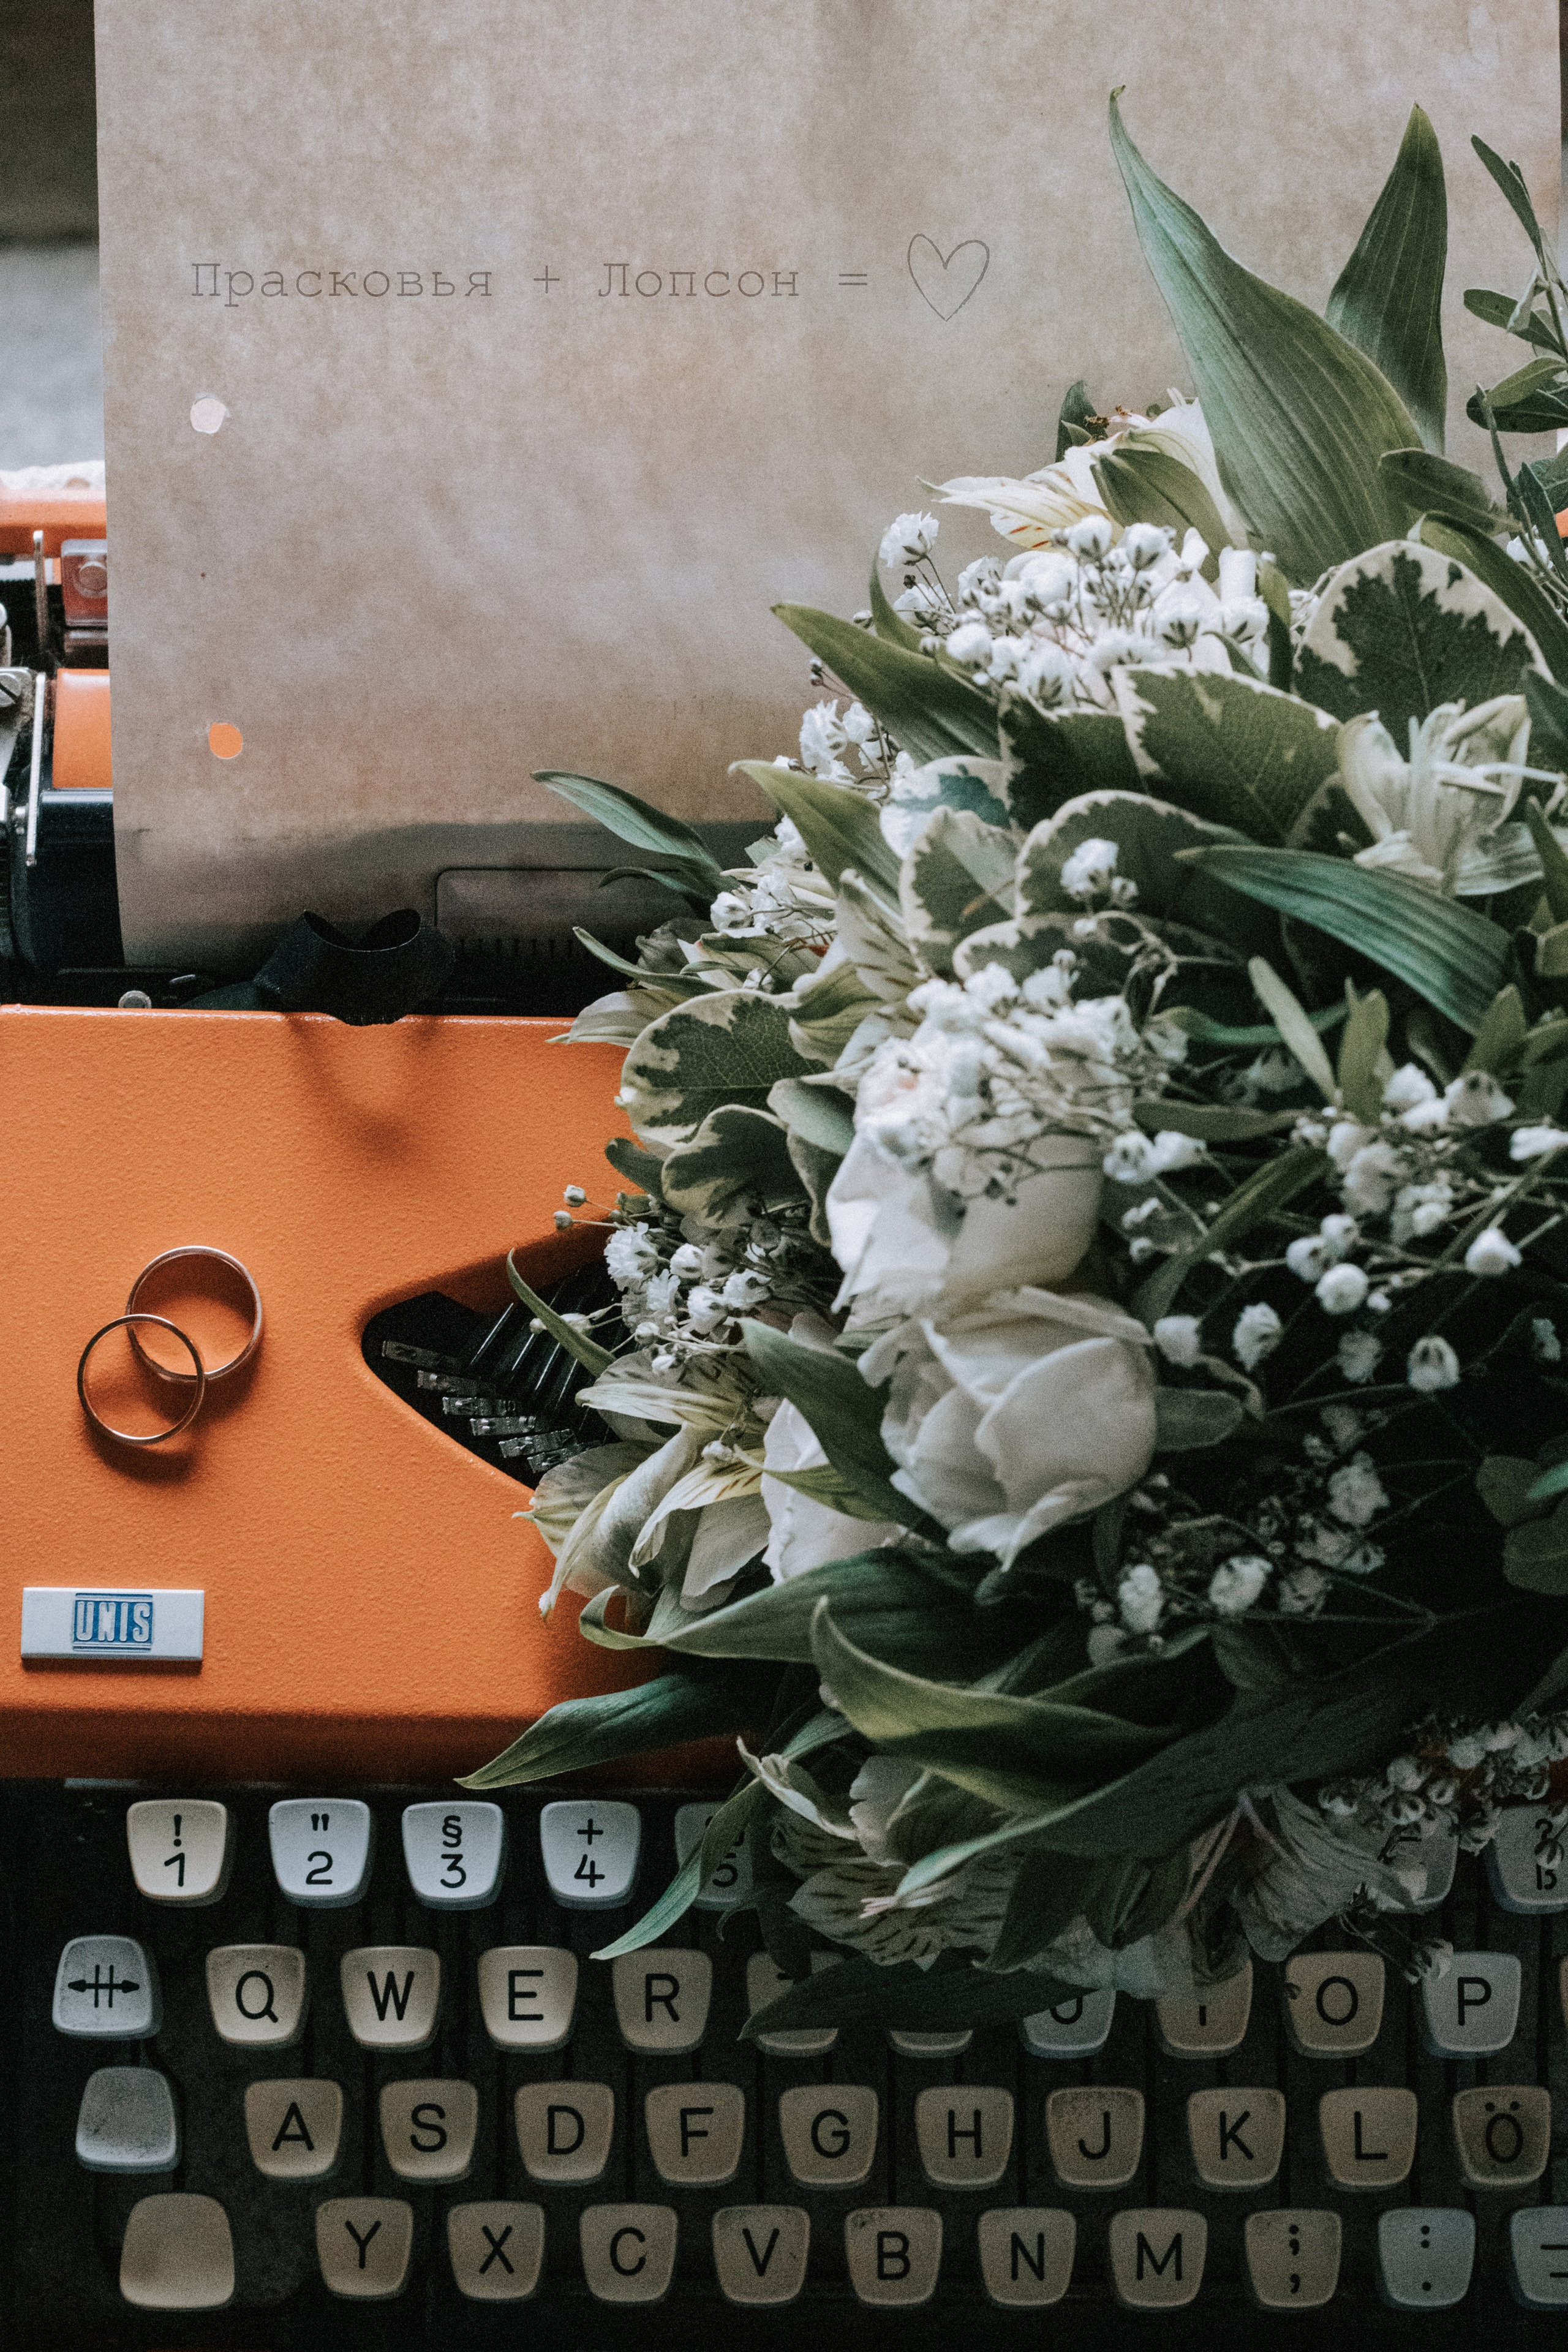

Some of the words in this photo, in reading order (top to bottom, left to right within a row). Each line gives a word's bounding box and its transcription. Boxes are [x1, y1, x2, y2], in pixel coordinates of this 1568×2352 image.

[192, 263, 492, 307] Прасковья
[533, 265, 560, 294] +
[598, 263, 799, 297] Лопсон
[838, 273, 868, 286] =
[75, 1600, 151, 1642] UNIS
[173, 1814, 183, 1847] !
[442, 1814, 462, 1848] §
[577, 1818, 604, 1845] +
[164, 1852, 186, 1887] 1
[306, 1850, 333, 1885] 2
[440, 1853, 467, 1888] 3
[574, 1853, 605, 1888] 4
[235, 1969, 279, 2022] Q
[366, 1970, 416, 2021] W
[507, 1969, 545, 2021] E
[644, 1973, 680, 2022] R
[1316, 1976, 1359, 2026] O
[1457, 1977, 1492, 2026] P
[271, 2101, 314, 2151] A
[410, 2103, 448, 2153] S
[547, 2105, 586, 2155] D
[680, 2106, 714, 2157] F
[810, 2109, 851, 2159] G
[948, 2109, 983, 2159] H
[1078, 2111, 1112, 2161] J
[1219, 2111, 1254, 2160] K
[1354, 2111, 1389, 2162] L
[1485, 2101, 1525, 2165] Ö
[345, 2220, 382, 2269] Y
[479, 2226, 514, 2274] X
[609, 2226, 646, 2277] C
[742, 2228, 780, 2277] V
[876, 2231, 911, 2281] B
[1011, 2233, 1045, 2282] N
[1136, 2233, 1183, 2282] M
